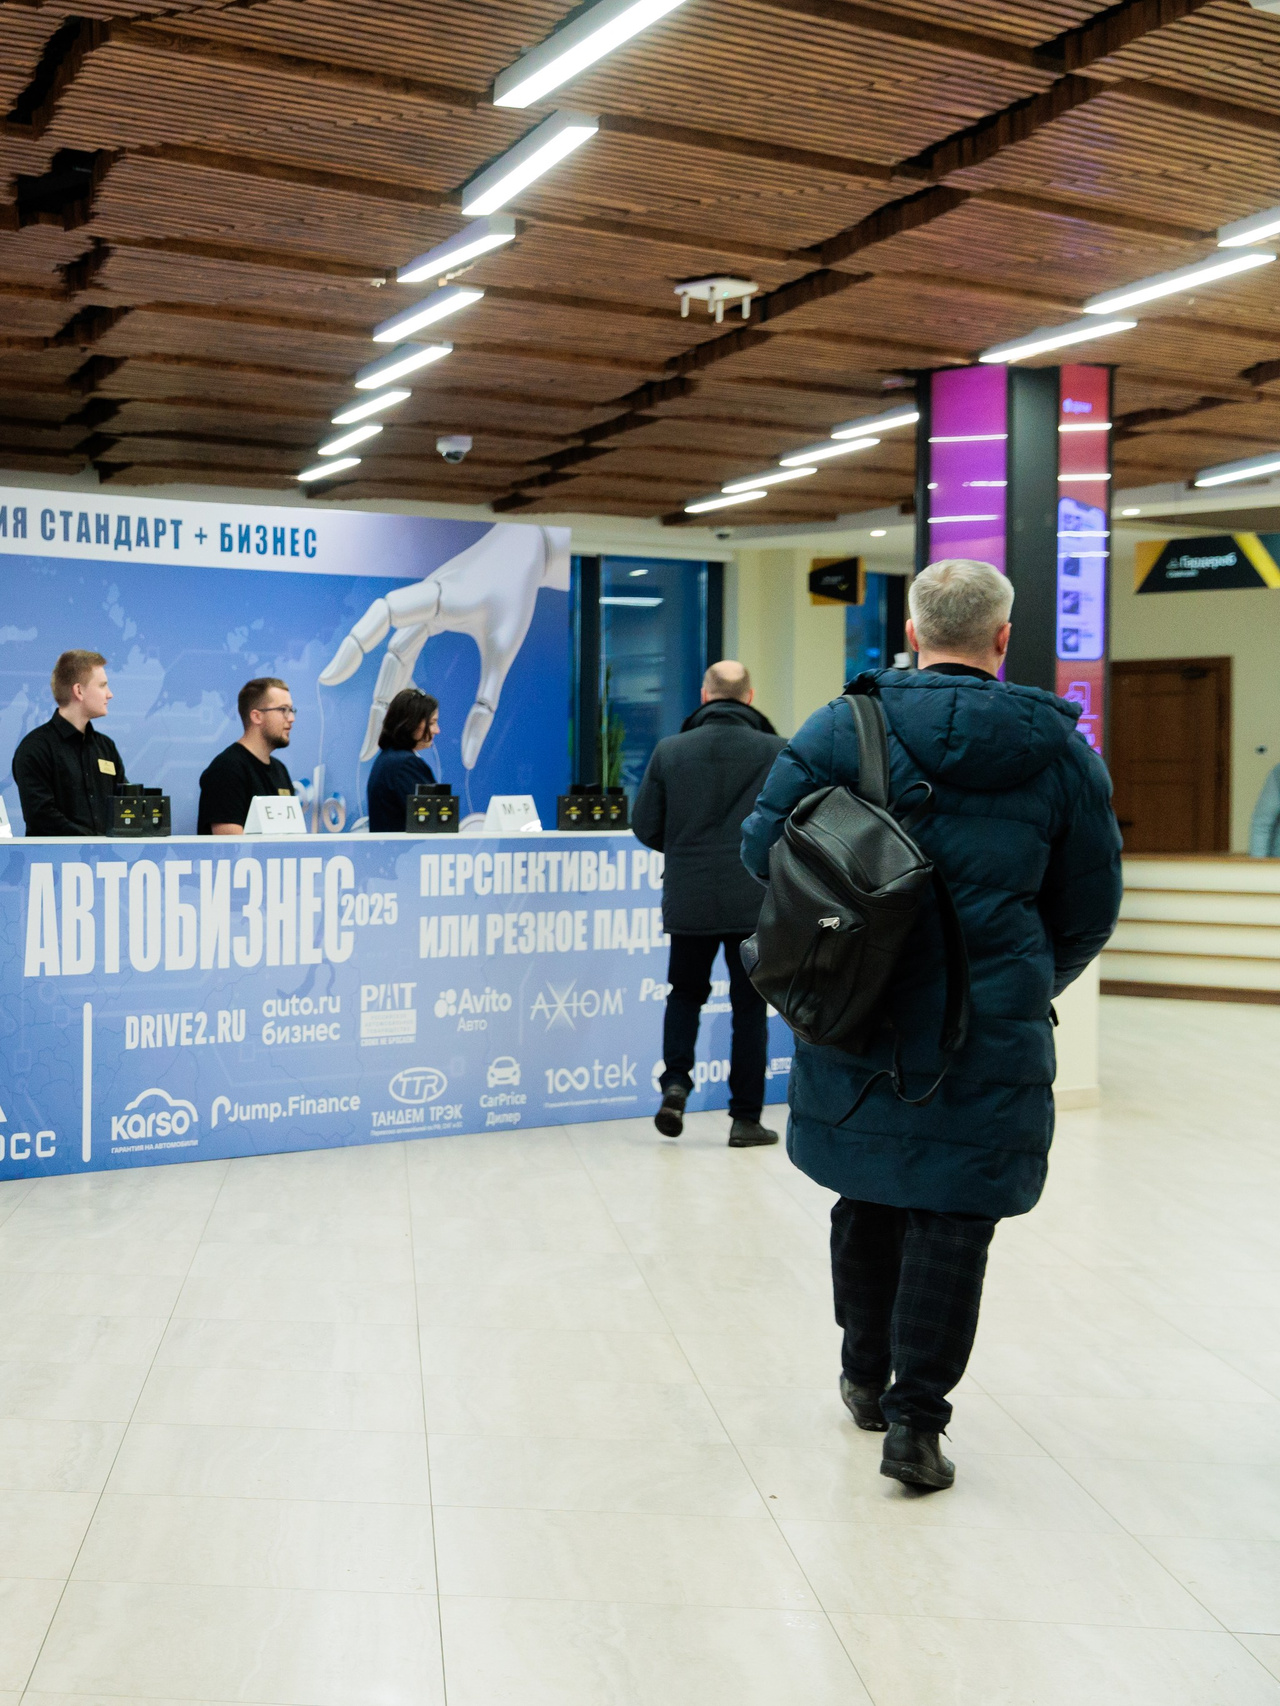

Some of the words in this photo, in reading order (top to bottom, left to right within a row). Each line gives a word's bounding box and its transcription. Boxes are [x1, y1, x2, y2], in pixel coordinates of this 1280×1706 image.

[40, 508, 183, 552] СТАНДАРТ
[194, 528, 208, 545] +
[220, 523, 318, 558] БИЗНЕС
[420, 850, 626, 897] ПЕРСПЕКТИВЫ
[24, 855, 355, 977] АВТОБИЗНЕС
[340, 893, 398, 927] 2025
[420, 914, 479, 959] ИЛИ
[486, 909, 587, 955] РЕЗКОЕ
[593, 907, 670, 955] ПАДЕ
[262, 994, 341, 1018] auto.ru
[457, 986, 512, 1014] Avito
[125, 1009, 246, 1050] DRIVE2.RU
[262, 1020, 341, 1045] бизнес
[456, 1017, 488, 1032] Авто
[228, 1094, 361, 1123] Jump.Finance
[479, 1091, 527, 1108] CarPrice
[111, 1110, 190, 1141] karso
[371, 1107, 425, 1127] ТАНДЕМ
[429, 1104, 464, 1122] ТРЭК
[485, 1111, 521, 1126] Дилер
